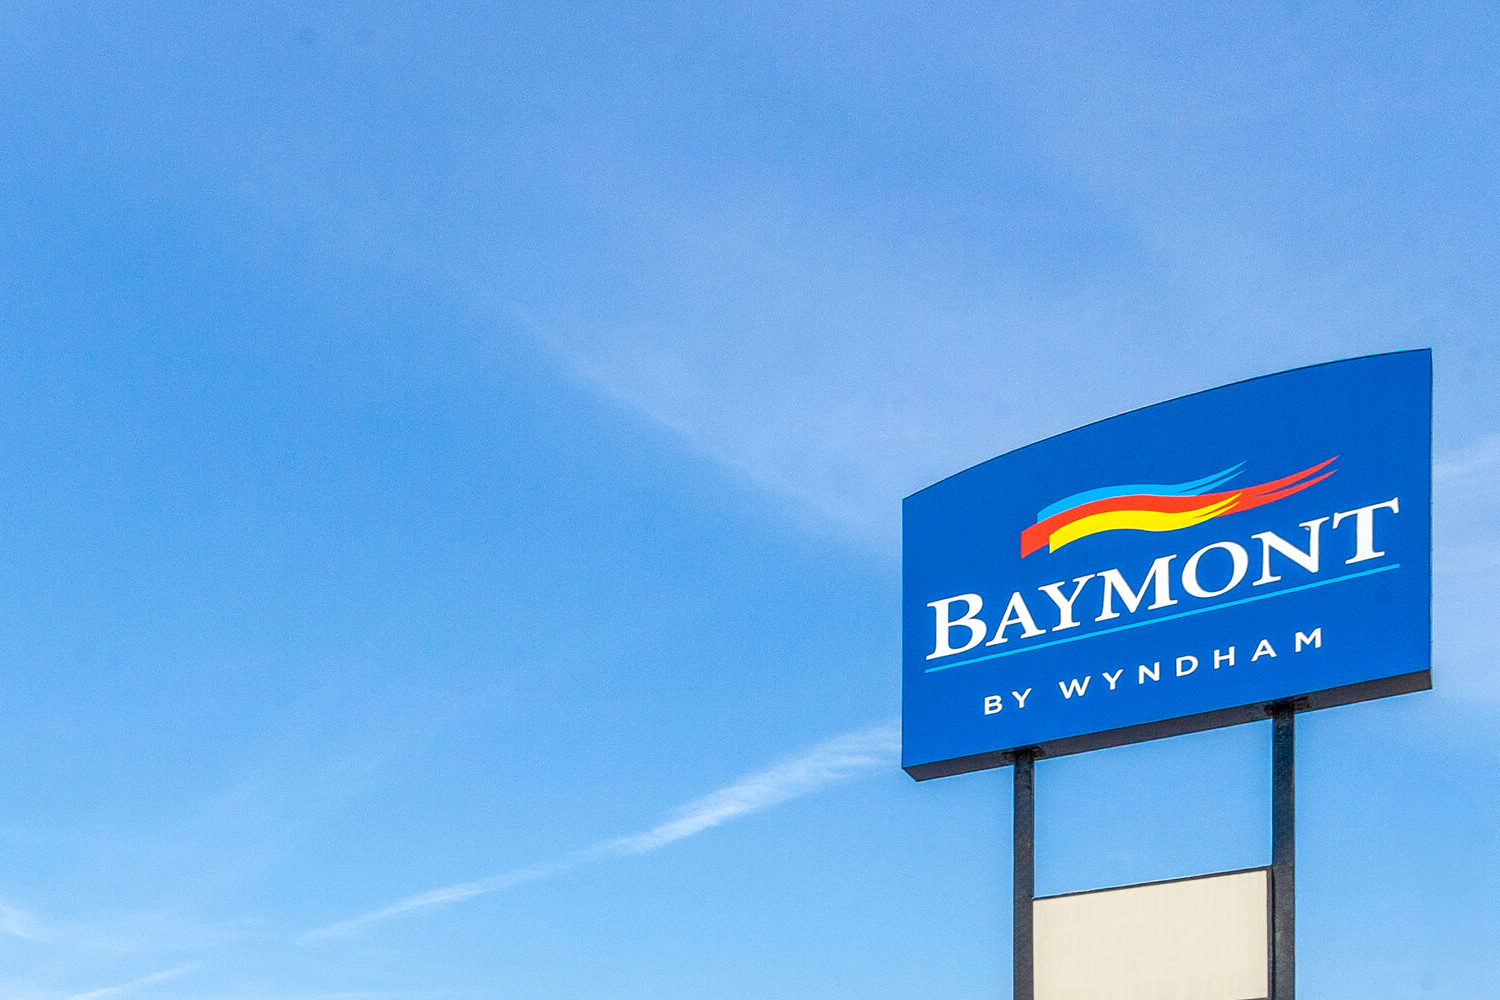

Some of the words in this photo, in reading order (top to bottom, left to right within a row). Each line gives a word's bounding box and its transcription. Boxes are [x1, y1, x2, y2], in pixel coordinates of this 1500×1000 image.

[926, 496, 1400, 661] BAYMONT
[984, 688, 1032, 716] BY
[1058, 627, 1322, 700] WYNDHAM
